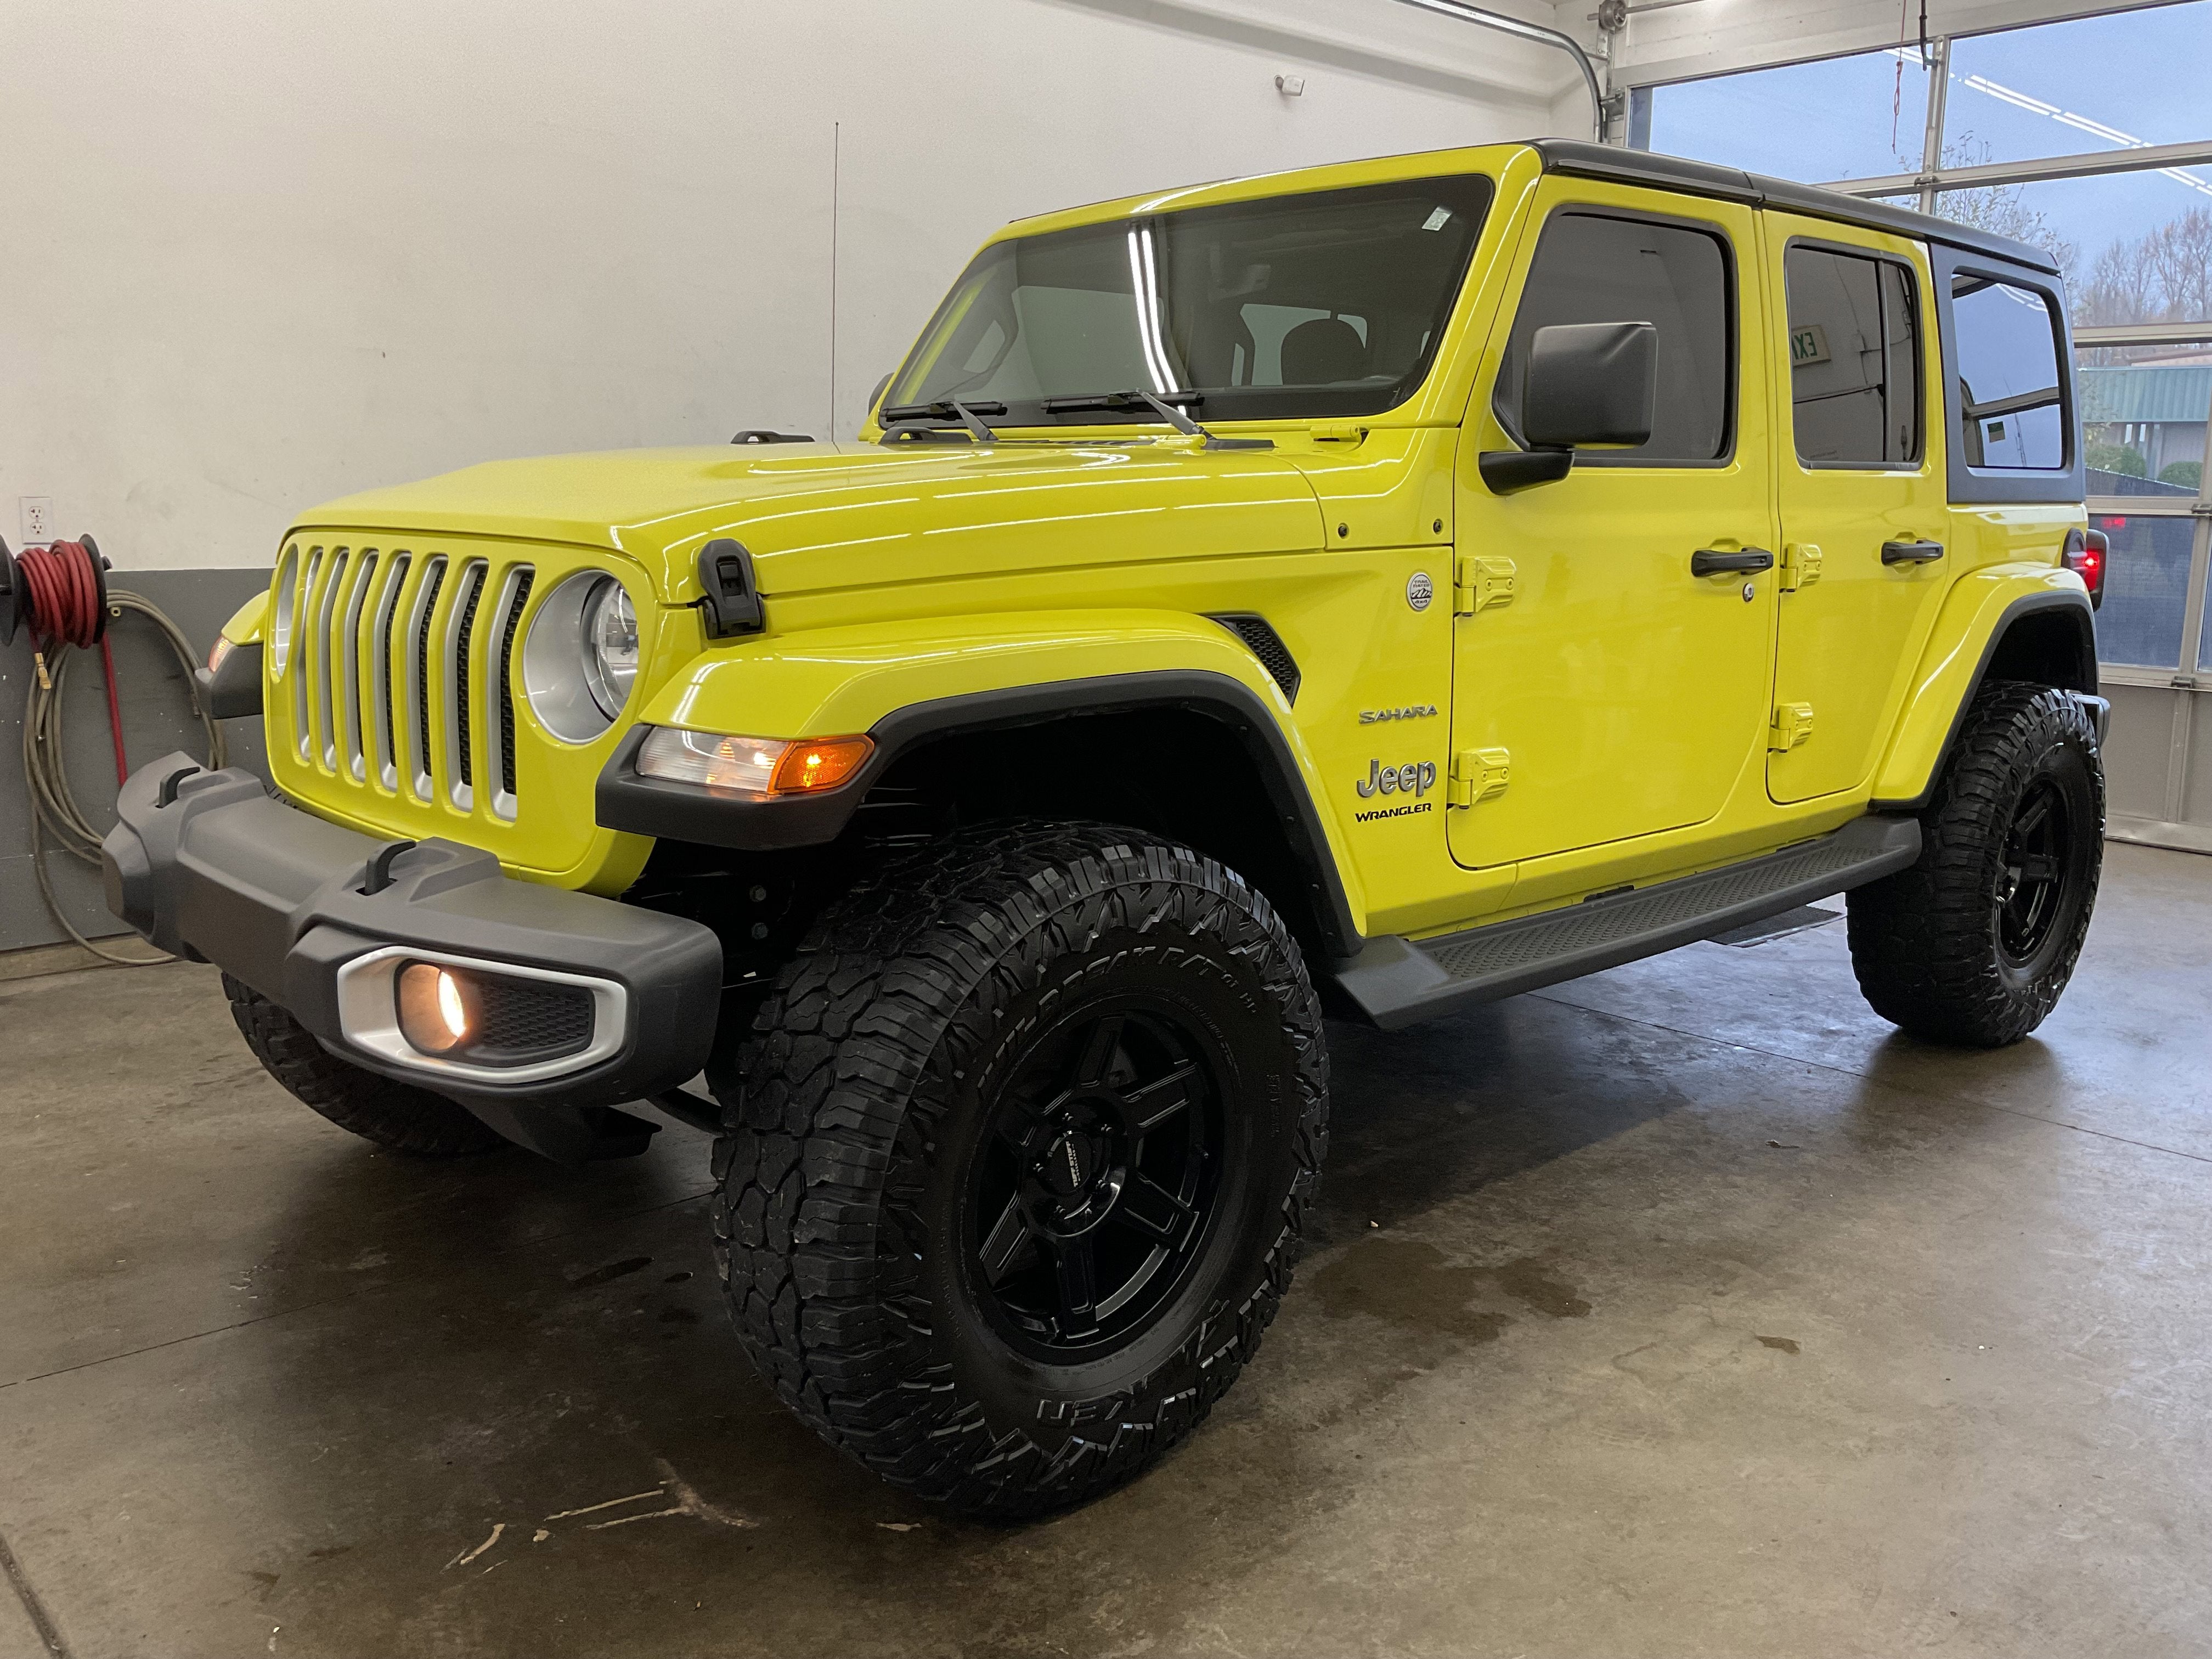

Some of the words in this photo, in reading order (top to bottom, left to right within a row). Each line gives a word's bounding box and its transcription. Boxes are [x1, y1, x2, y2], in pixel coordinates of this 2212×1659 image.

[1358, 704, 1438, 724] SAHARA
[1356, 758, 1436, 798] Jeep
[1355, 802, 1432, 823] WRANGLER
